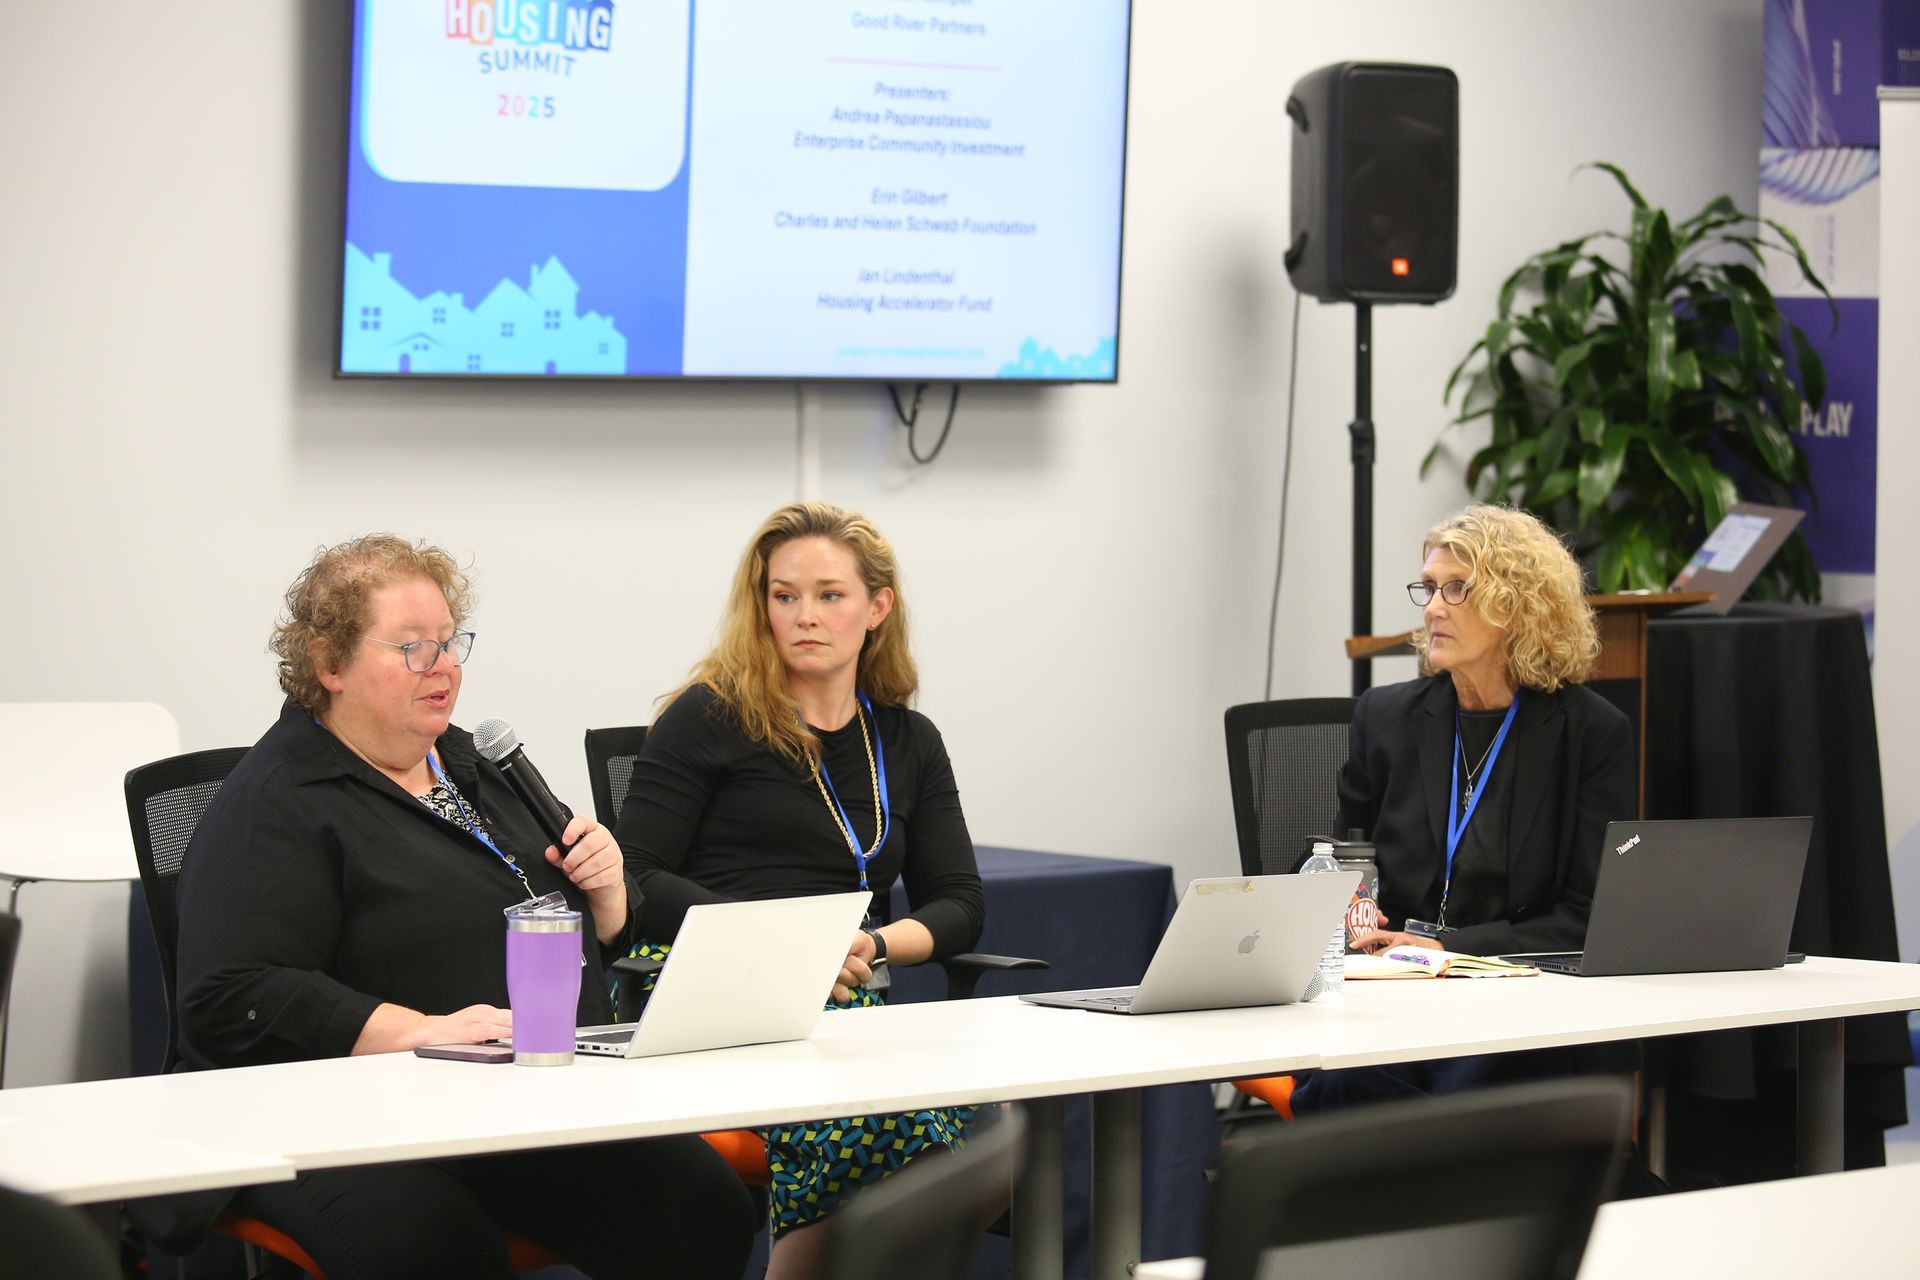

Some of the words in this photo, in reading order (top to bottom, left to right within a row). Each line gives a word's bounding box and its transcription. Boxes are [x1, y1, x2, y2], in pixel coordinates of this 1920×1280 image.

[447, 0, 611, 48] HOUSING
[851, 10, 889, 29] Good
[893, 14, 926, 31] River
[930, 16, 985, 35] Partners
[479, 50, 577, 77] SUMMIT
[874, 82, 950, 101] Presenters:
[497, 94, 556, 118] 2025
[831, 107, 881, 124] Andrea
[794, 131, 863, 150] Enterprise
[868, 135, 947, 156] Community
[951, 139, 1025, 157] Investment
[871, 188, 897, 204] Erin
[901, 189, 948, 205] Gilbert
[774, 211, 828, 228] Charles
[833, 216, 857, 229] and
[862, 216, 901, 230] Helen
[905, 216, 959, 232] Schwab
[962, 218, 1038, 234] Foundation
[857, 269, 879, 283] Jan
[884, 269, 955, 284] Lindenthal
[816, 294, 873, 313] Housing
[878, 295, 955, 310] Accelerator
[959, 296, 993, 312] Fund
[1616, 834, 1641, 856] ThinkPad
